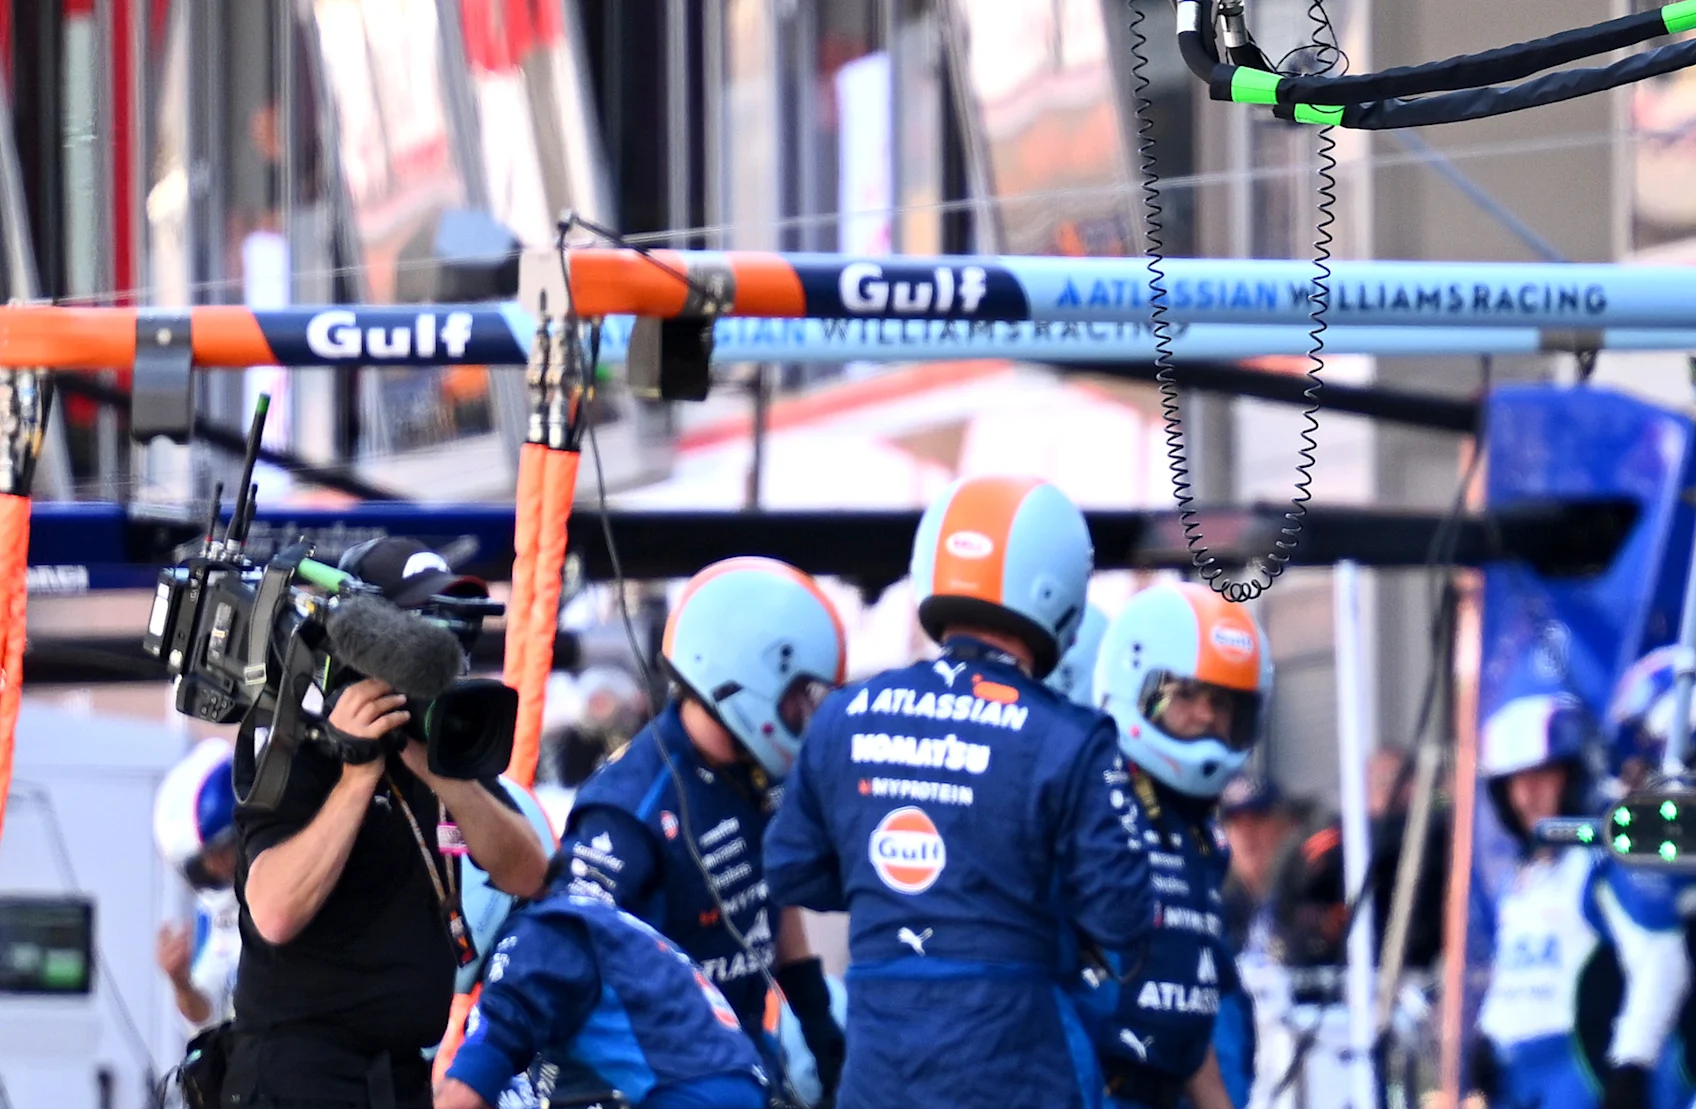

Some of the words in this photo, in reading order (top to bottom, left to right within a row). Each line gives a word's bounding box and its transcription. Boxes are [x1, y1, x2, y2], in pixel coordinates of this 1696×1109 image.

[838, 262, 987, 314] Gulf
[1089, 278, 1278, 311] ATLASSIAN
[1287, 281, 1468, 314] WILLIAMS
[1473, 283, 1608, 316] RACING
[306, 309, 473, 358] Gulf
[870, 688, 1029, 731] ATLASSIAN
[851, 733, 991, 775] KOMATSU
[872, 776, 974, 807] MYPROTEIN
[878, 837, 940, 862] Gulf
